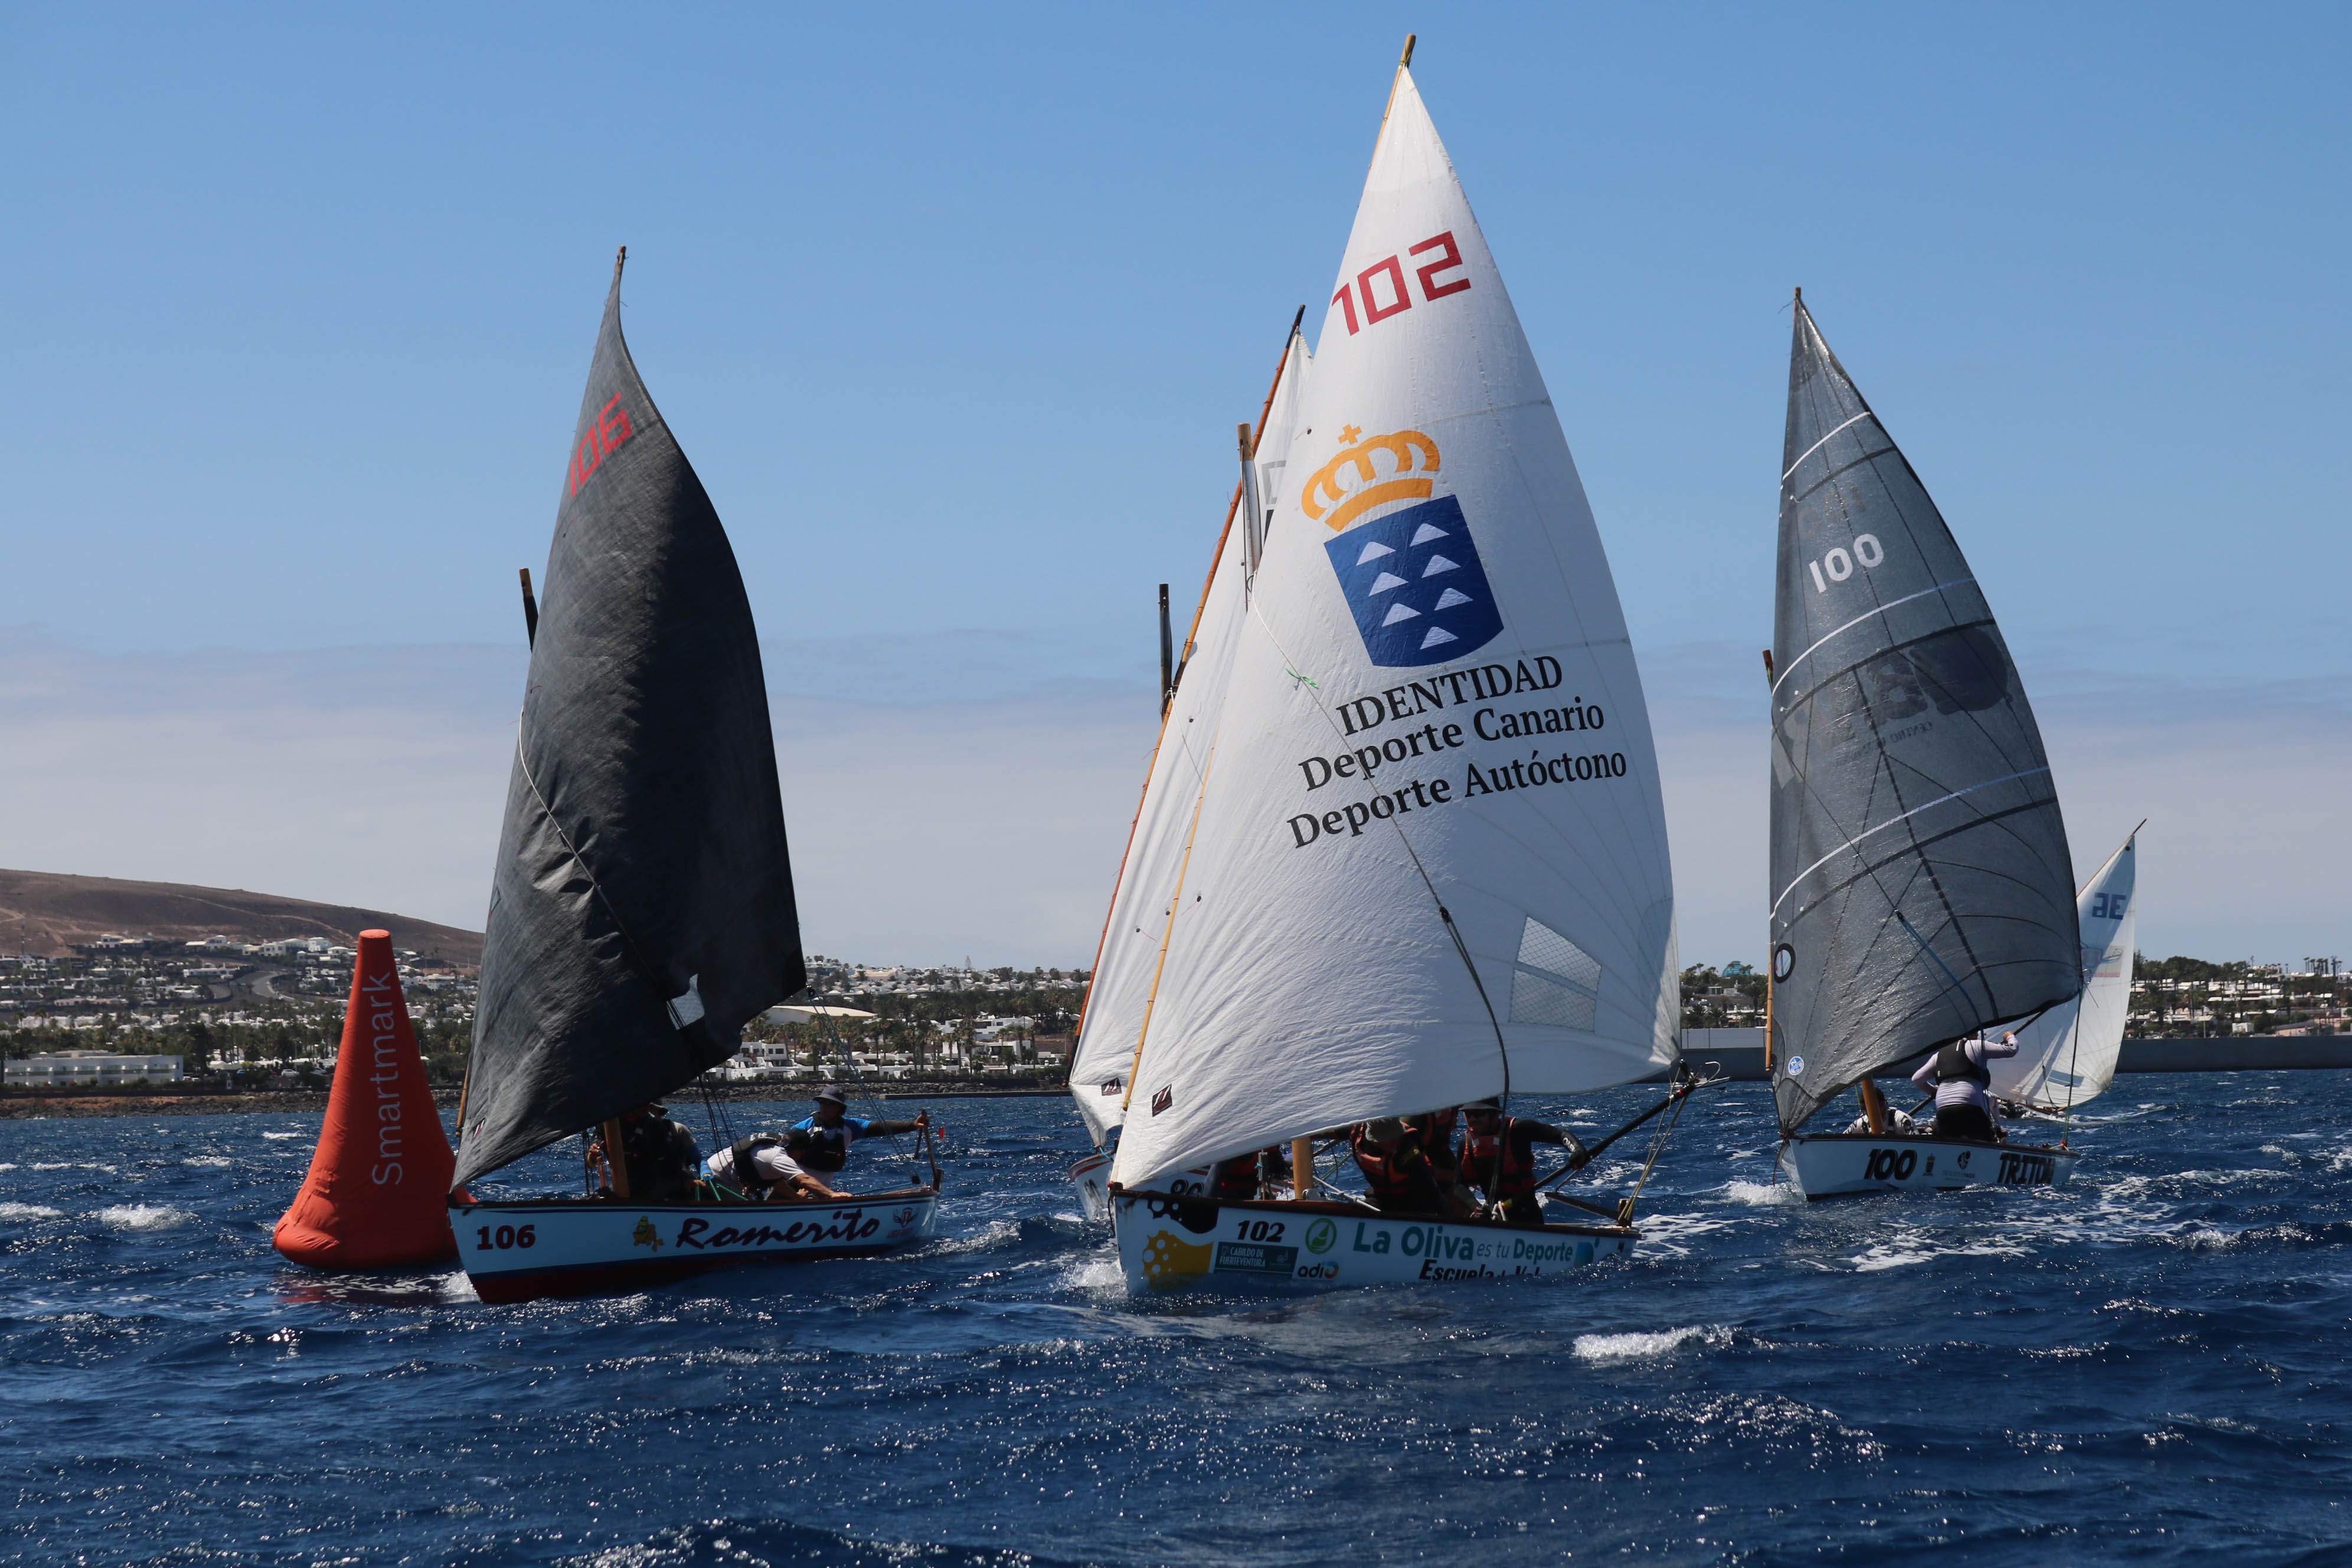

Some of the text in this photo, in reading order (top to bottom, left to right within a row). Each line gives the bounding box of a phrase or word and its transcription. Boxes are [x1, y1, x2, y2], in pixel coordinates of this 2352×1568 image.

[1332, 230, 1471, 336] 102
[1809, 534, 1884, 593] 100
[1336, 655, 1563, 737] IDENTIDAD
[1298, 696, 1605, 791] Deporte Canario
[1287, 750, 1627, 848] Deporte Autóctono
[362, 972, 403, 1185] Smartmark
[1864, 1148, 1917, 1181] 100
[476, 1224, 535, 1251] 106
[677, 1208, 881, 1250] Romerito
[1237, 1220, 1285, 1243] 102
[1353, 1221, 1573, 1265] La Oliva es tu Deporte
[1220, 1256, 1266, 1268] FUERTEVENTURA
[1230, 1246, 1265, 1258] CABILDO DE
